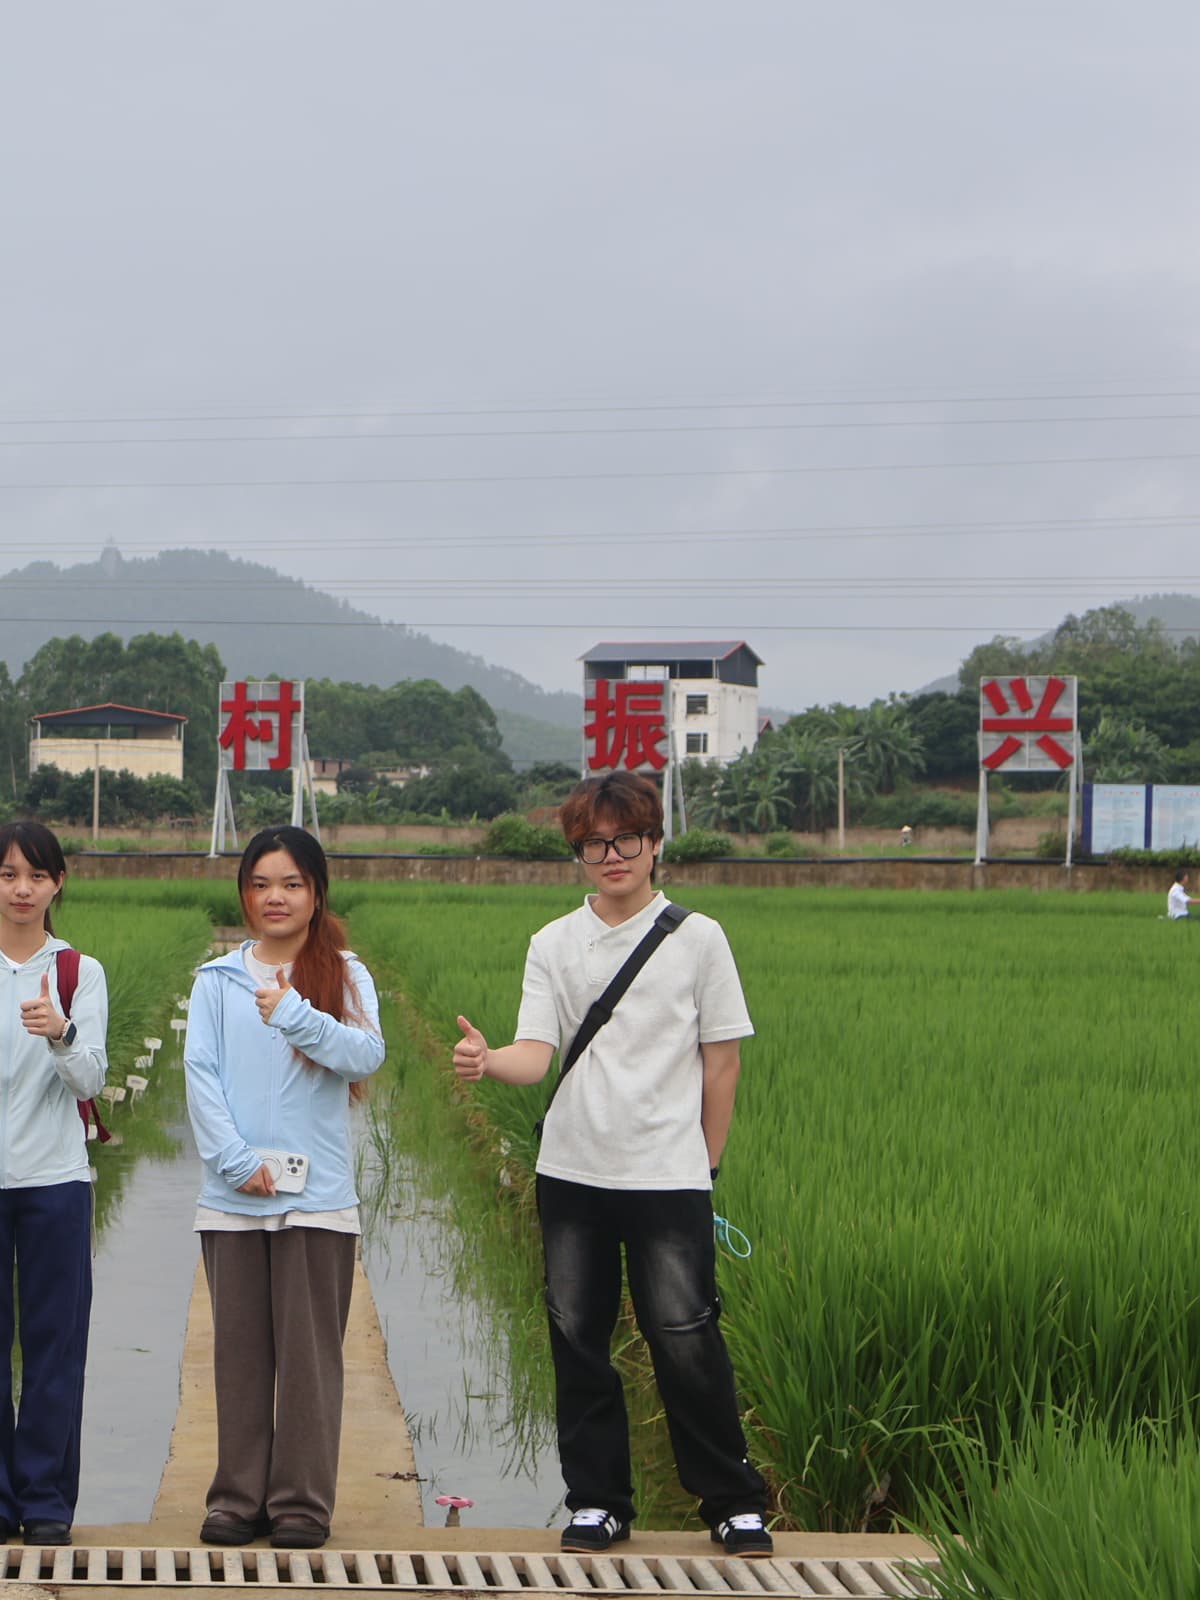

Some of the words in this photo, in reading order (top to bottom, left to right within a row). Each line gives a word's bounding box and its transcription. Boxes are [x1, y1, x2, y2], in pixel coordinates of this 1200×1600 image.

[218, 681, 302, 771] 村
[584, 678, 668, 771] 振
[982, 678, 1074, 770] 兴
